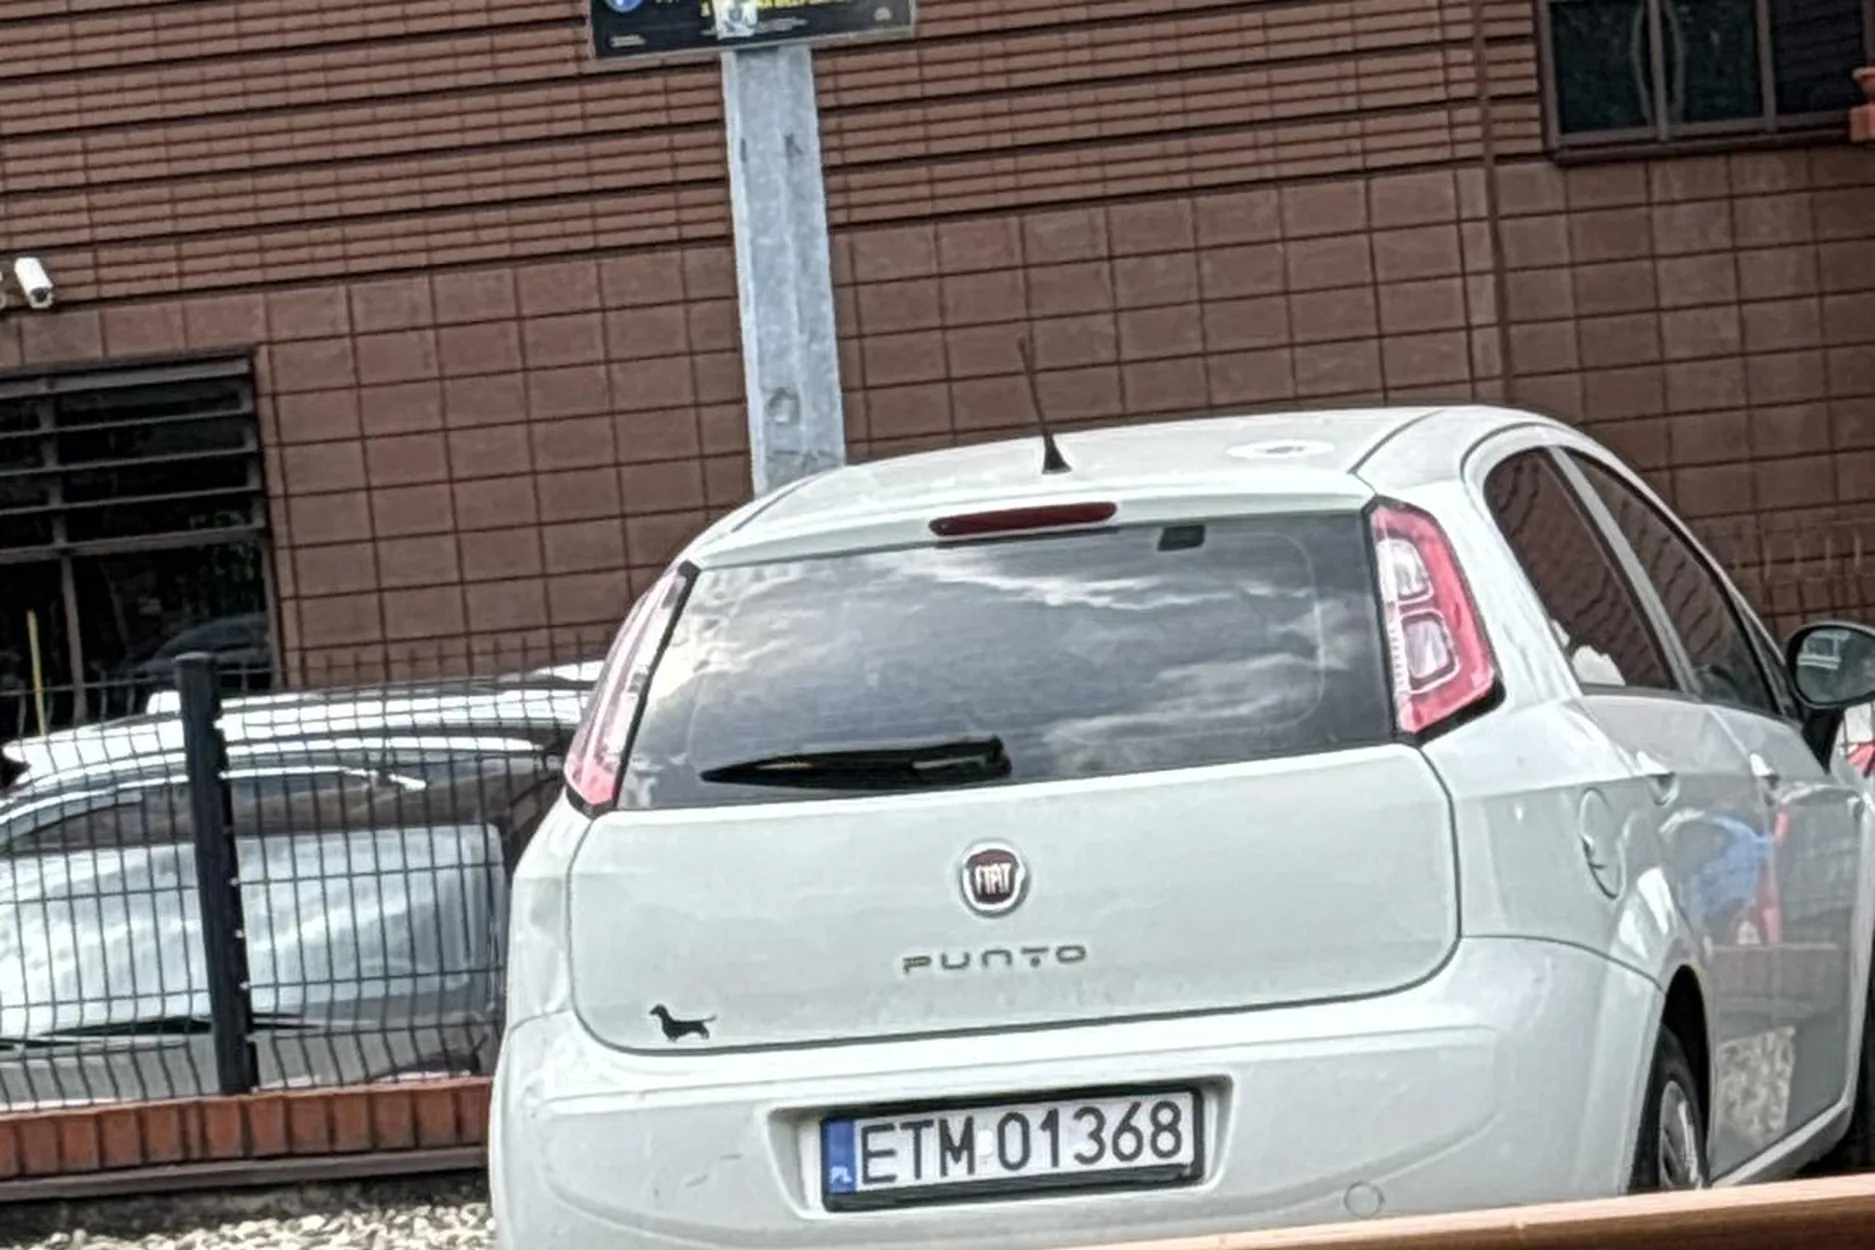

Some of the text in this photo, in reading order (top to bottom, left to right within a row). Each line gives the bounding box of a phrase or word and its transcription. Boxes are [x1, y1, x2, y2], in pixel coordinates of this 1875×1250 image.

[975, 862, 1012, 894] FIAT
[903, 945, 1087, 975] PUNTO
[861, 1099, 1183, 1185] ETM 01368
